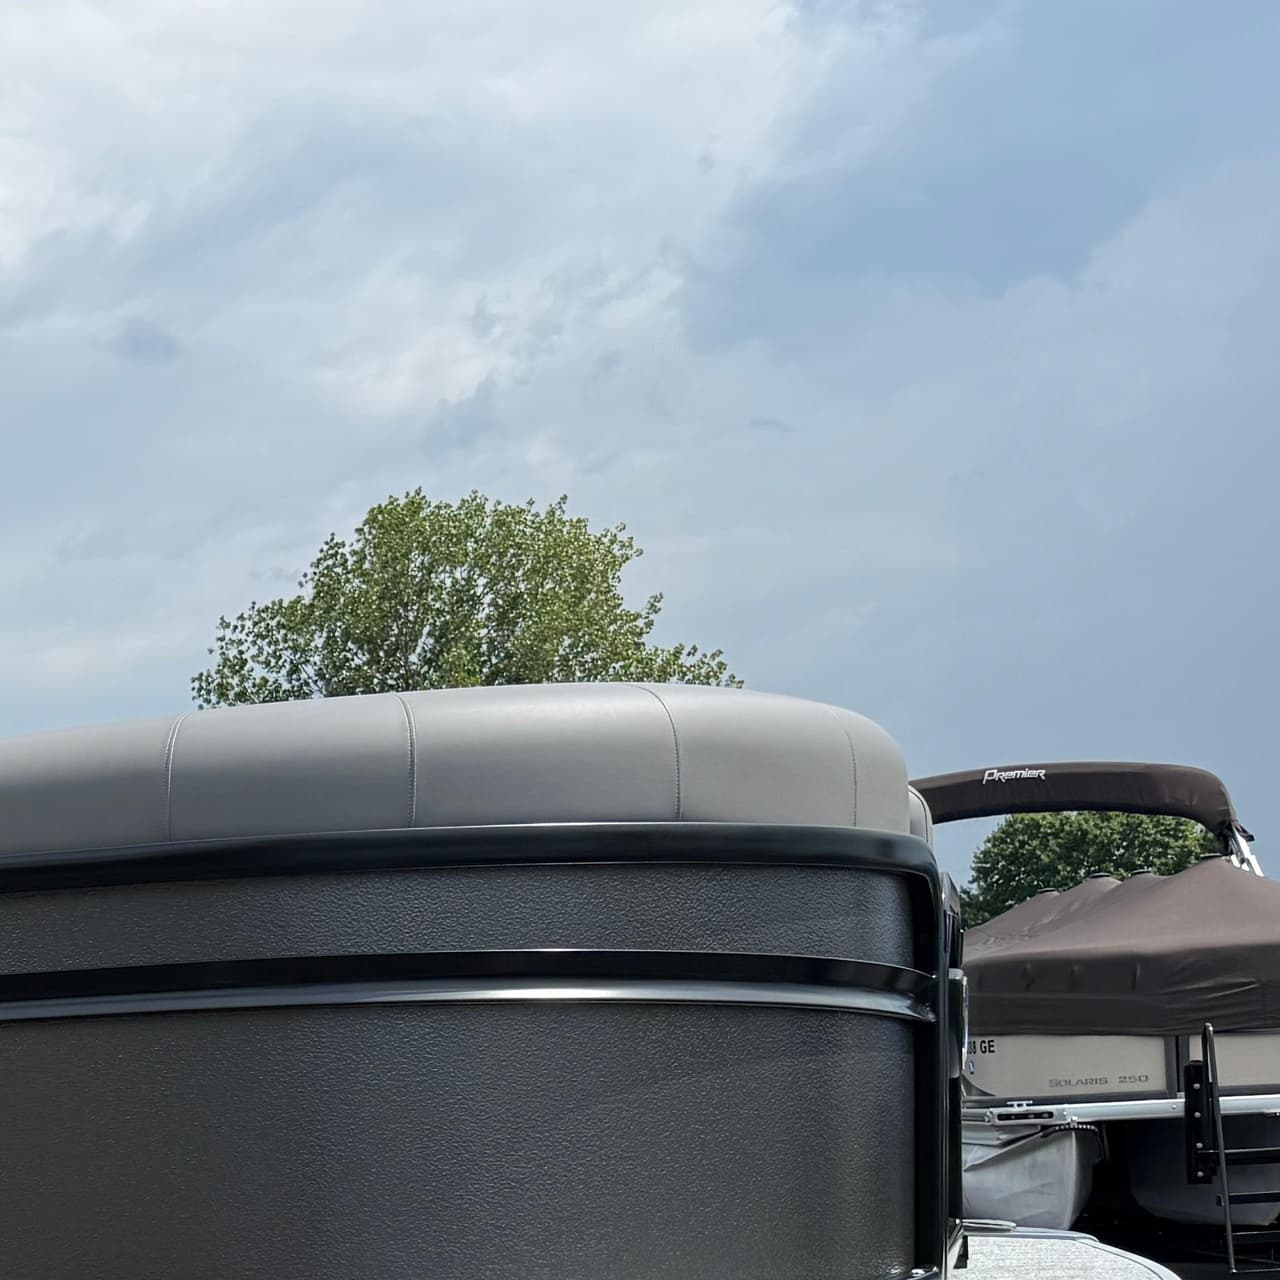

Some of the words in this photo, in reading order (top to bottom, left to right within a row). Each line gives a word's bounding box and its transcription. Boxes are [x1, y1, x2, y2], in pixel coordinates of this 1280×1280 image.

[980, 1040, 995, 1054] GE
[1048, 1077, 1109, 1088] SOLARIS
[1118, 1074, 1149, 1084] 250
